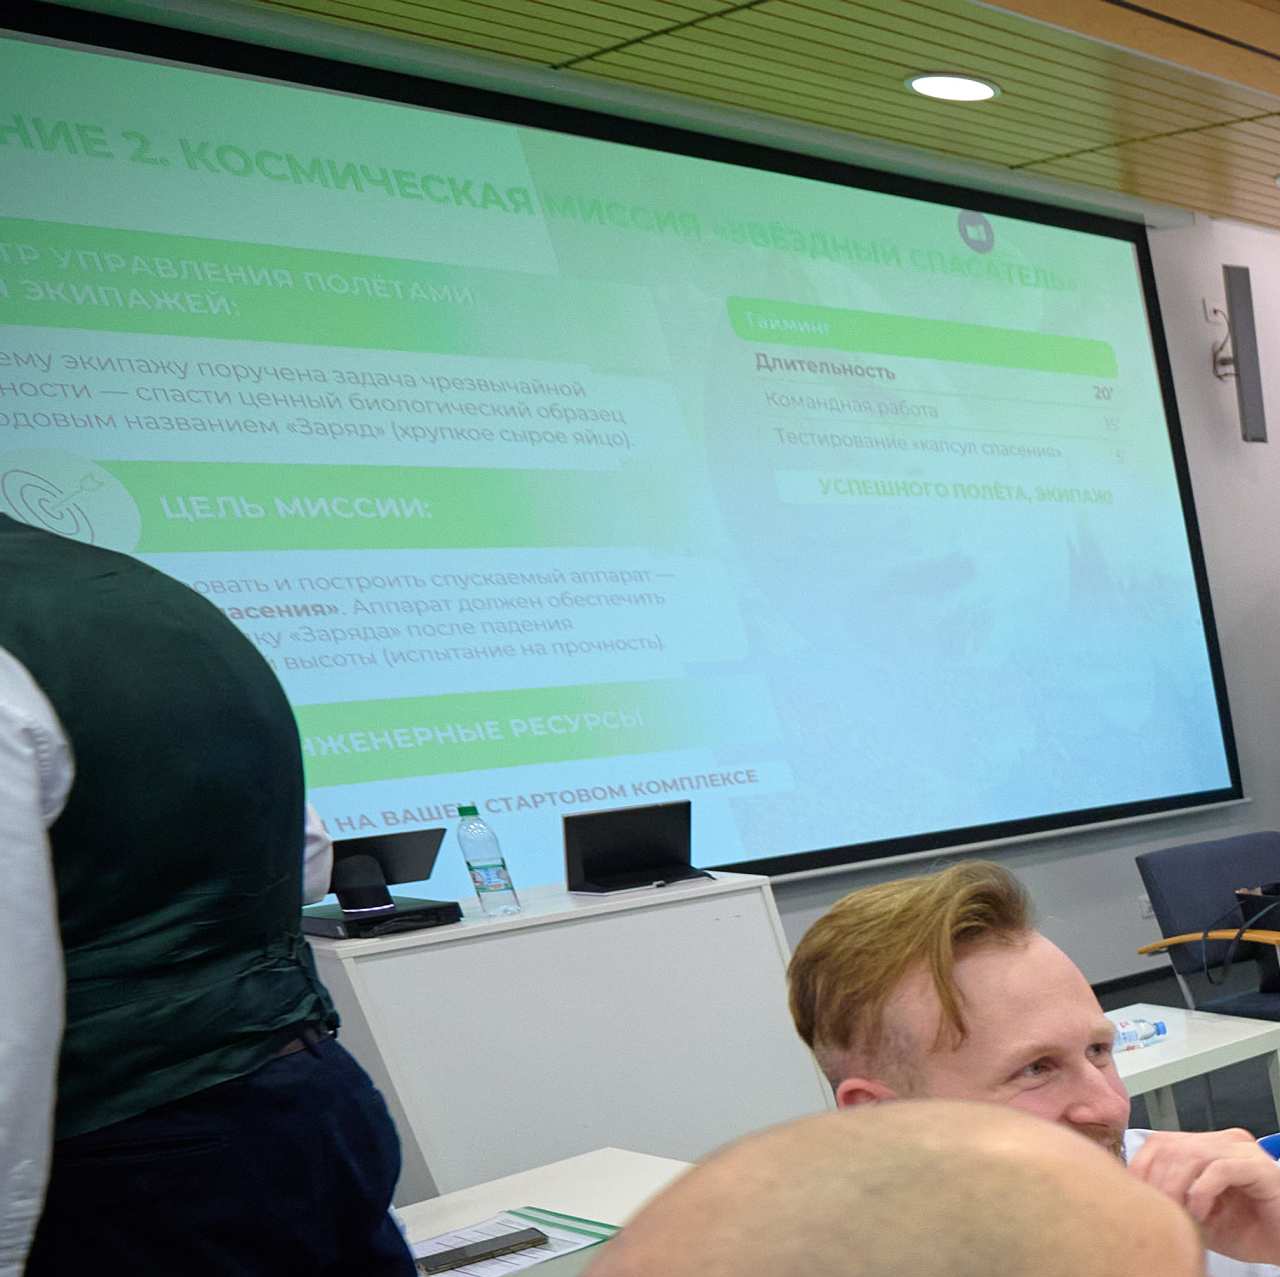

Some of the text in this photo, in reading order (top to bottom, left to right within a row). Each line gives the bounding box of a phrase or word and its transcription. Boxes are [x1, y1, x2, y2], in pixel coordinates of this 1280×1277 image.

[121, 128, 169, 168] 2.
[178, 136, 537, 217] КОСМИЧЕСКАЯ
[548, 196, 701, 240] МИССИЯ
[54, 246, 294, 290] УПРАВЛЕНИЯ
[23, 277, 241, 319] ЭКИПАЖЕЙ:
[62, 353, 189, 380] экипажу
[198, 359, 328, 385] поручена
[333, 368, 417, 392] задача
[422, 373, 587, 400] чрезвычайной
[755, 352, 896, 382] Длительность
[135, 384, 233, 406] спасти
[239, 389, 346, 413] ценный
[349, 394, 531, 420] биологический
[536, 404, 628, 427] образец
[765, 389, 939, 422] Командная работа
[125, 414, 280, 435] названием
[286, 415, 386, 441] «Заряд»
[392, 420, 495, 446] (хрупкое
[499, 427, 568, 447] сырое
[773, 427, 909, 456] Тестирование
[818, 476, 950, 501] УСПЕШНОГО
[161, 494, 433, 525] ЦЕЛЬ МИССИИ:
[276, 577, 292, 592] и
[298, 572, 426, 594] построить
[430, 566, 566, 590] спускаемый
[571, 568, 652, 589] аппарат
[352, 597, 453, 619] Аппарат
[457, 594, 543, 615] должен
[547, 590, 666, 611] обеспечить
[289, 615, 573, 647] «Заряда» после падения
[285, 632, 666, 671] высоты (испытание на прочность).
[511, 706, 644, 742] РЕСУРСЫ
[334, 768, 758, 834] НА ВАШЕ СТАРТОВОМ КОМПЛЕКСЕ
